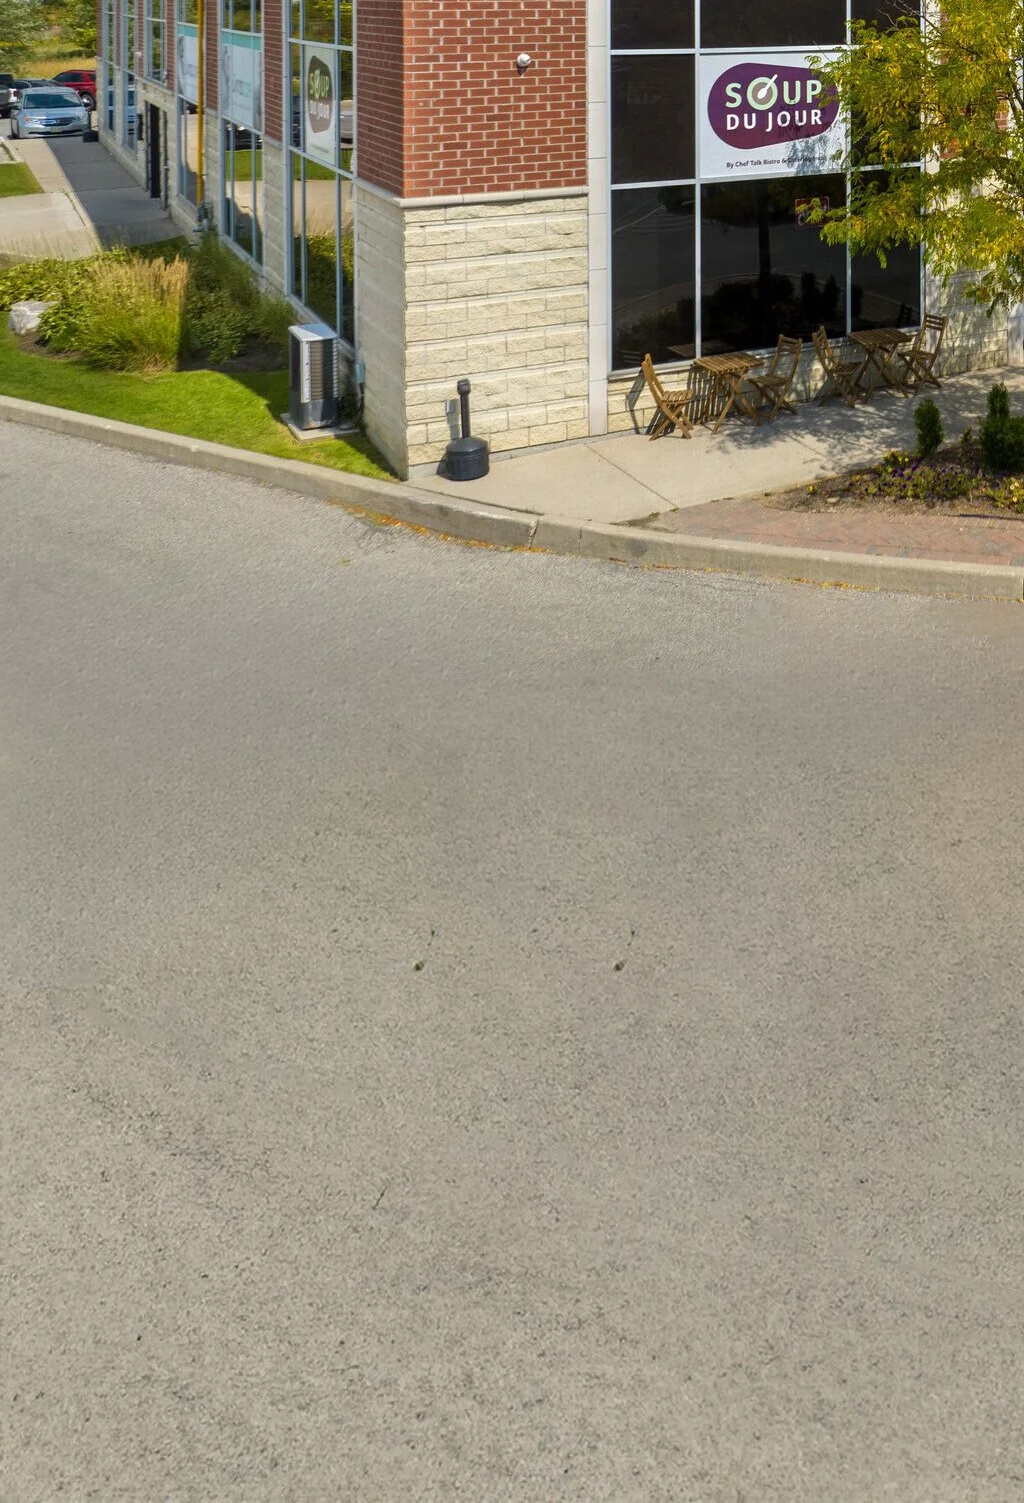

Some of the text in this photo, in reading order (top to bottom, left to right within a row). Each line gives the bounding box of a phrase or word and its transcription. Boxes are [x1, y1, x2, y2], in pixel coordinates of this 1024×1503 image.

[725, 74, 822, 111] SOUP
[726, 109, 822, 132] DU JOUR
[727, 161, 734, 169] By
[735, 160, 749, 168] Chef
[763, 158, 780, 166] Bistro
